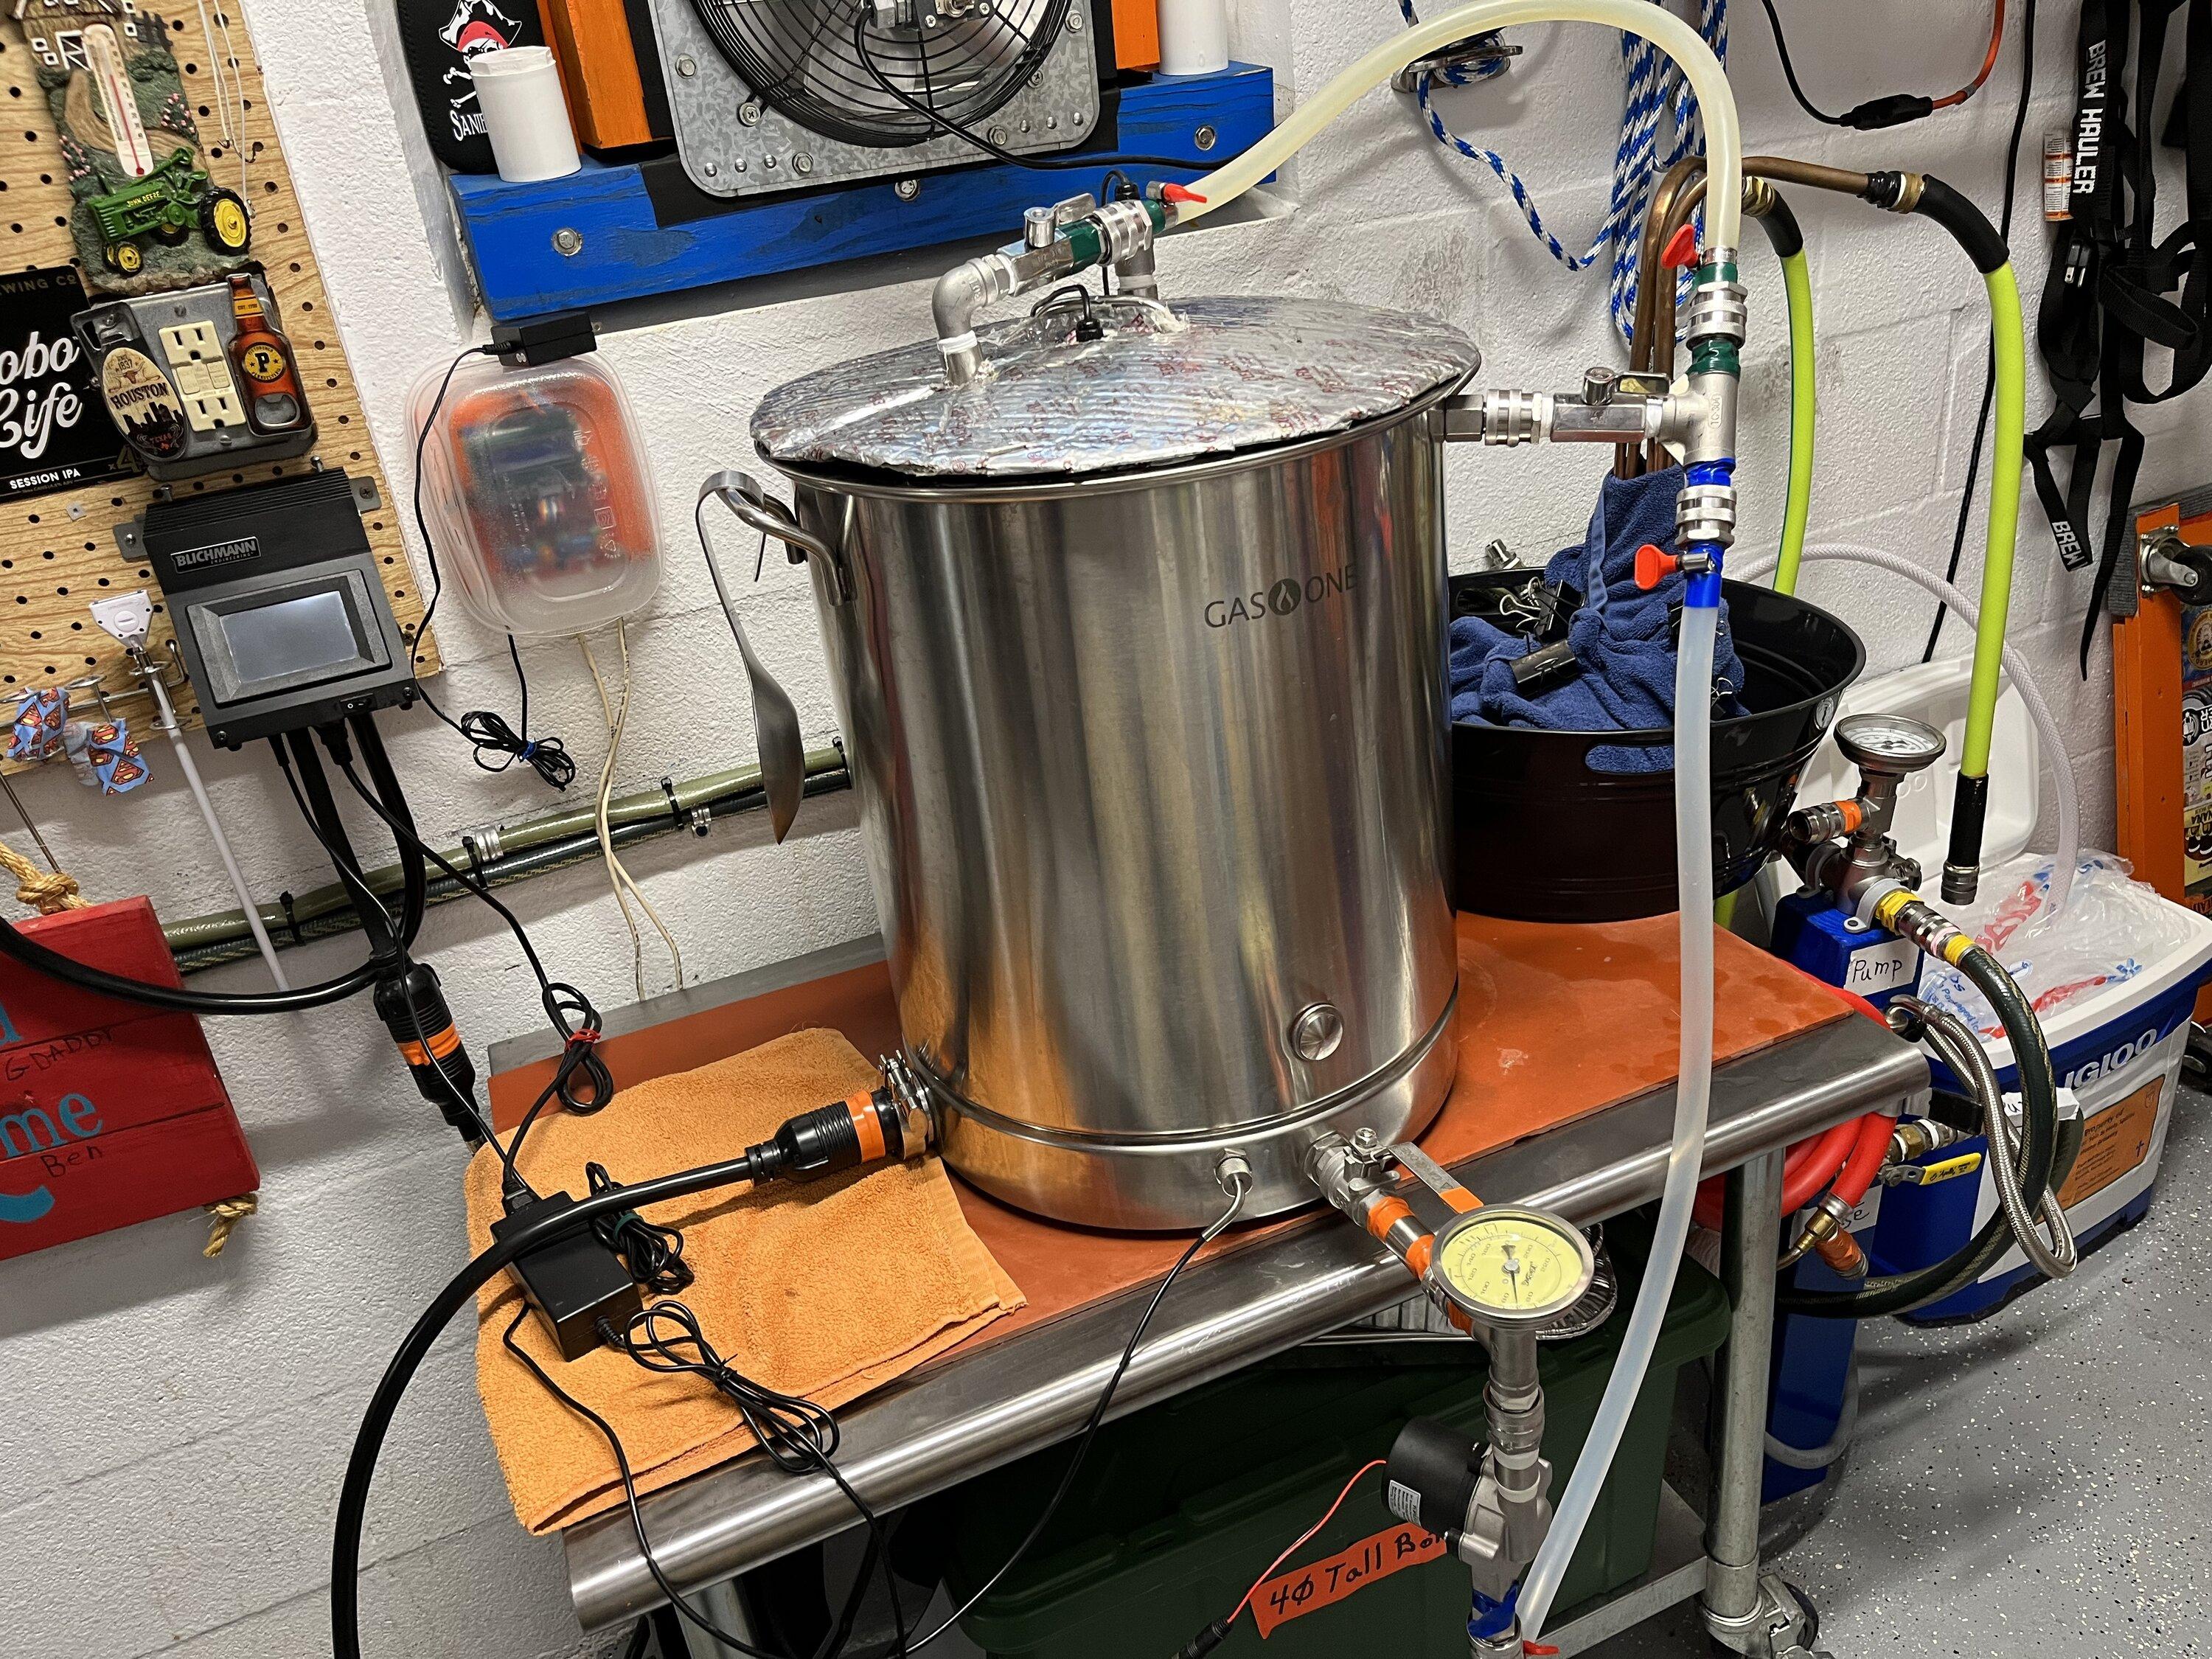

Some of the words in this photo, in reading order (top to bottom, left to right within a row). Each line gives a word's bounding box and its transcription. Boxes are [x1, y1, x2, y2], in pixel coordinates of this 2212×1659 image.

[2083, 40, 2107, 99] BREW
[2072, 108, 2104, 194] HAULER
[142, 191, 160, 203] DEERE
[0, 278, 49, 295] WING
[254, 352, 271, 373] P
[110, 382, 170, 409] HOUSTON
[9, 472, 60, 490] SESSION
[62, 468, 81, 479] IPA
[175, 540, 257, 567] BLICHMANN
[2052, 521, 2088, 571] BREW
[1204, 591, 1266, 628] GAS
[1304, 564, 1357, 603] ONE
[1852, 959, 1902, 983] Pump
[2065, 1029, 2158, 1088] IGLOO
[40, 1145, 102, 1178] Ben
[1479, 1280, 1491, 1295] 100
[1324, 1542, 1382, 1593] Tall
